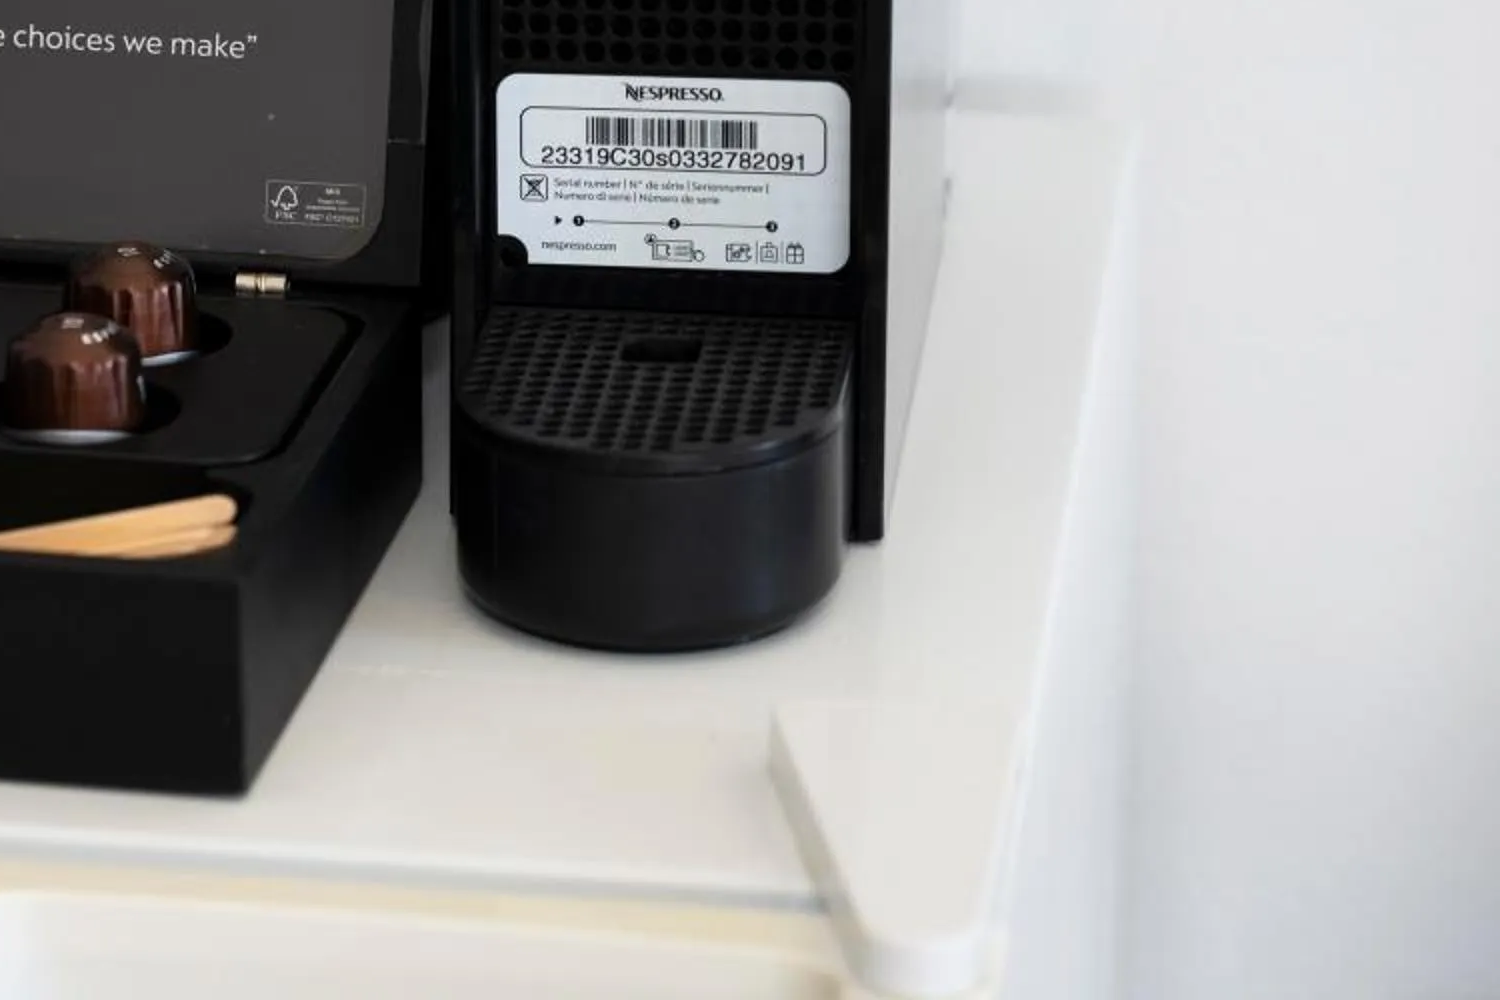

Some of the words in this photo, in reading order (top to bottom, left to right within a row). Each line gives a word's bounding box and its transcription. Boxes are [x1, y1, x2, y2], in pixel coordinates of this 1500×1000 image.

[13, 23, 116, 53] choices
[122, 34, 163, 55] we
[621, 81, 725, 102] NESPRESSO
[540, 146, 806, 172] 23319C30s0332782091
[553, 177, 581, 187] Serial
[583, 178, 622, 189] number
[541, 239, 618, 252] nespresso.com
